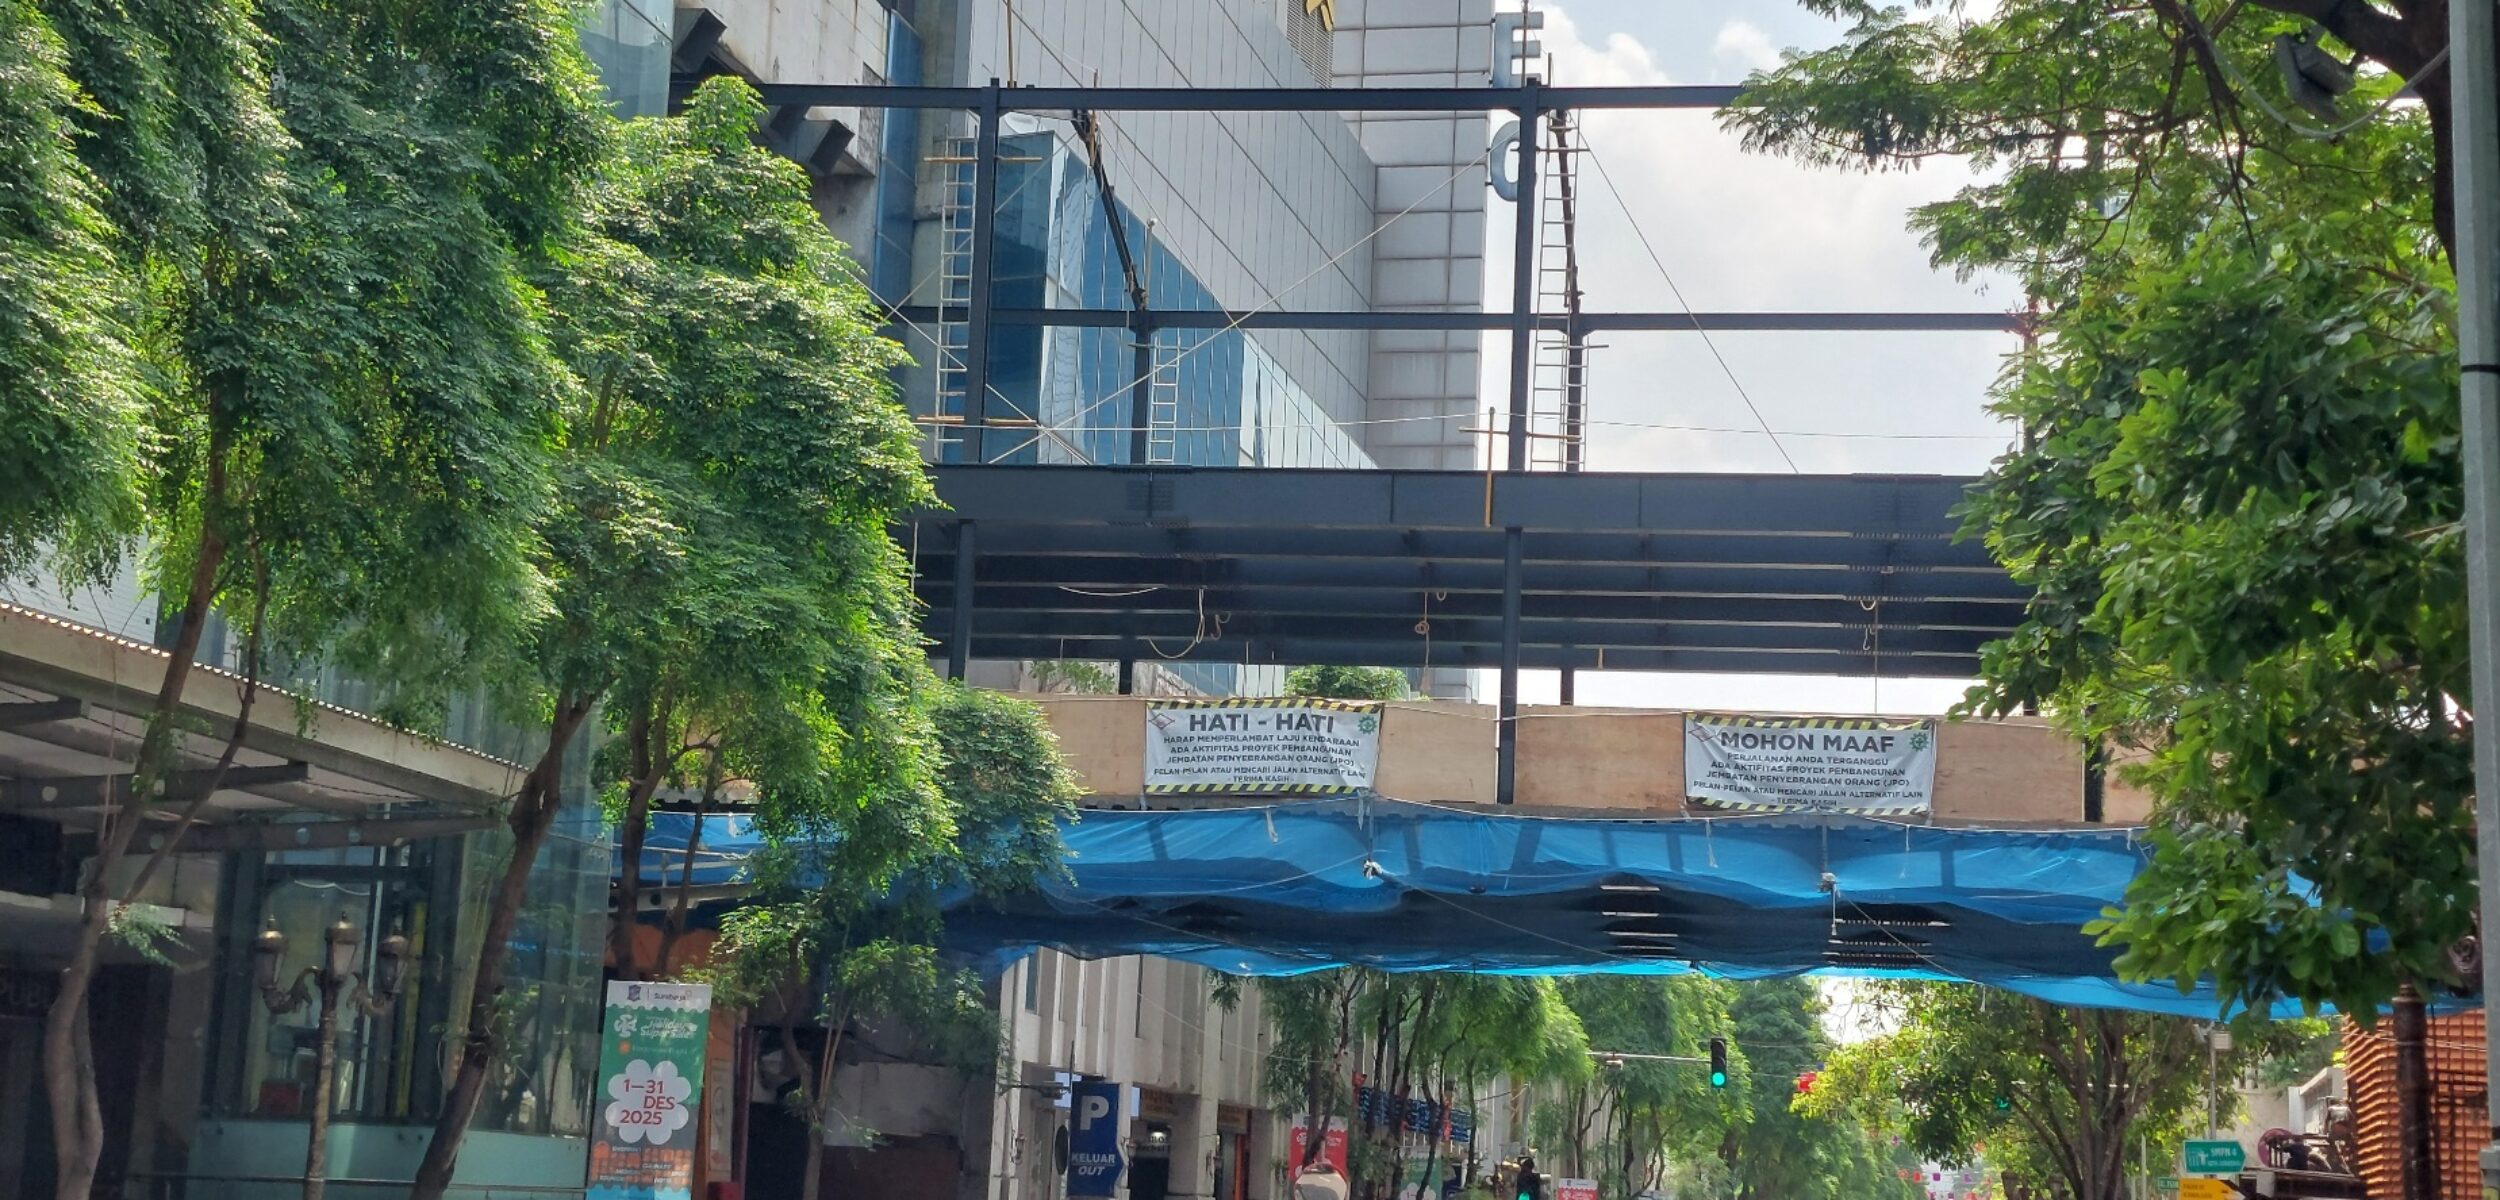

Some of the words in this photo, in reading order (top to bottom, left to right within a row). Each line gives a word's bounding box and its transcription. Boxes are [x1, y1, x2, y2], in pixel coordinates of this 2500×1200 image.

[1189, 713, 1249, 732] HATI
[1276, 713, 1334, 733] HATI
[1163, 735, 1195, 744] HARAP
[1197, 735, 1274, 743] MEMPERLAMBAT
[1302, 735, 1360, 747] KENDARAAN
[1720, 732, 1814, 750] MOHON
[1823, 734, 1895, 753] MAAF
[1170, 746, 1190, 754] ADA
[1192, 745, 1240, 753] AKTIFITAS
[1242, 744, 1279, 753] PROYEK
[1281, 744, 1352, 757] PEMBANGUNAN
[1166, 755, 1215, 764] JEMBATAN
[1216, 754, 1295, 763] PENYEBRANGAN
[1296, 755, 1329, 763] ORANG
[1329, 757, 1354, 767] (JPO)
[1727, 752, 1793, 763] PERJALANAN
[1795, 756, 1824, 764] ANDA
[1826, 757, 1889, 766] TERGANGGU
[1233, 766, 1271, 774] MENCARI
[1273, 766, 1298, 774] JALAN
[1711, 760, 1731, 769] ADA
[1734, 762, 1784, 773] AKTIFITAS
[1785, 766, 1825, 774] PROYEK
[1828, 767, 1906, 777] PEMBANGUNAN
[1233, 775, 1264, 783] TERIMA
[1706, 770, 1757, 782] JEMBATAN
[1760, 775, 1842, 785] PENYEBRANGAN
[1844, 778, 1880, 786] ORANG
[1884, 779, 1910, 787] (JPO)
[1693, 780, 1751, 793] PELAN-PELAN
[1777, 788, 1816, 796] MENCARI
[643, 1095, 675, 1111] DES
[620, 1109, 662, 1125] 2025
[1080, 1095, 1109, 1131] P
[1071, 1152, 1116, 1164] KELUAR
[1078, 1165, 1105, 1176] OUT
